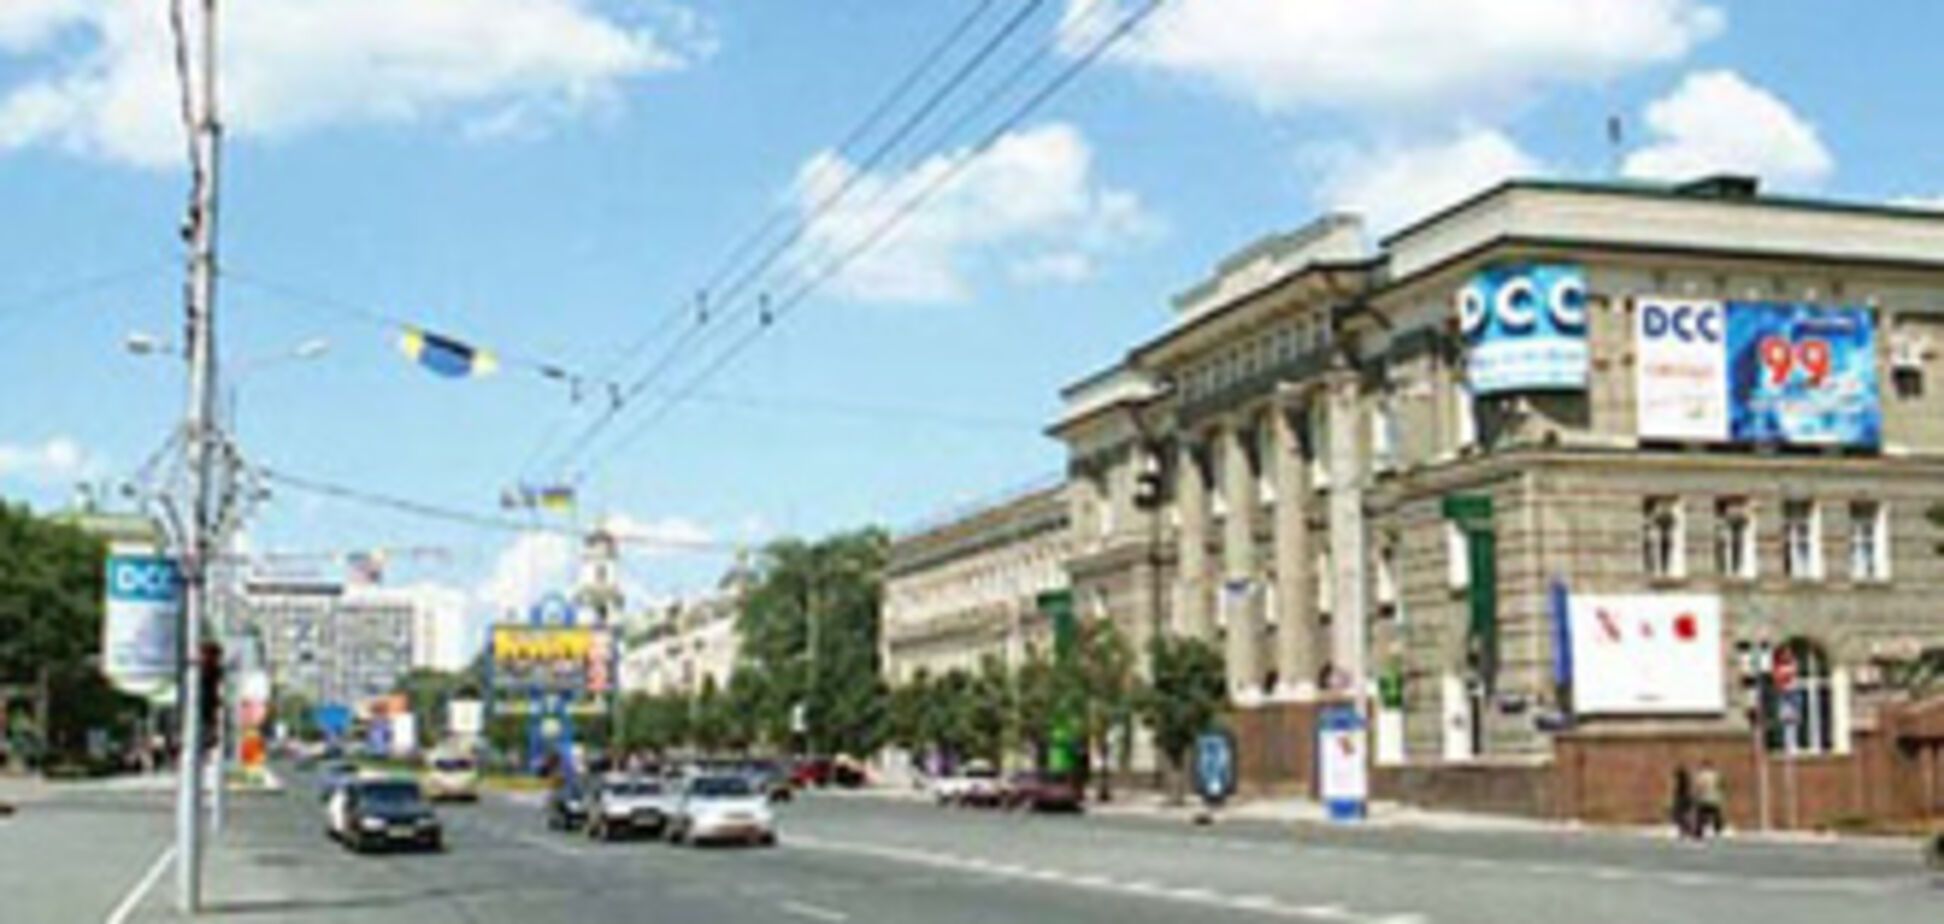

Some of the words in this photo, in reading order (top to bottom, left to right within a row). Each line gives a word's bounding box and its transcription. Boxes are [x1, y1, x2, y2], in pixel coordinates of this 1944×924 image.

[1457, 275, 1587, 333] DCC
[1642, 305, 1720, 343] DCC
[1760, 335, 1829, 387] 99
